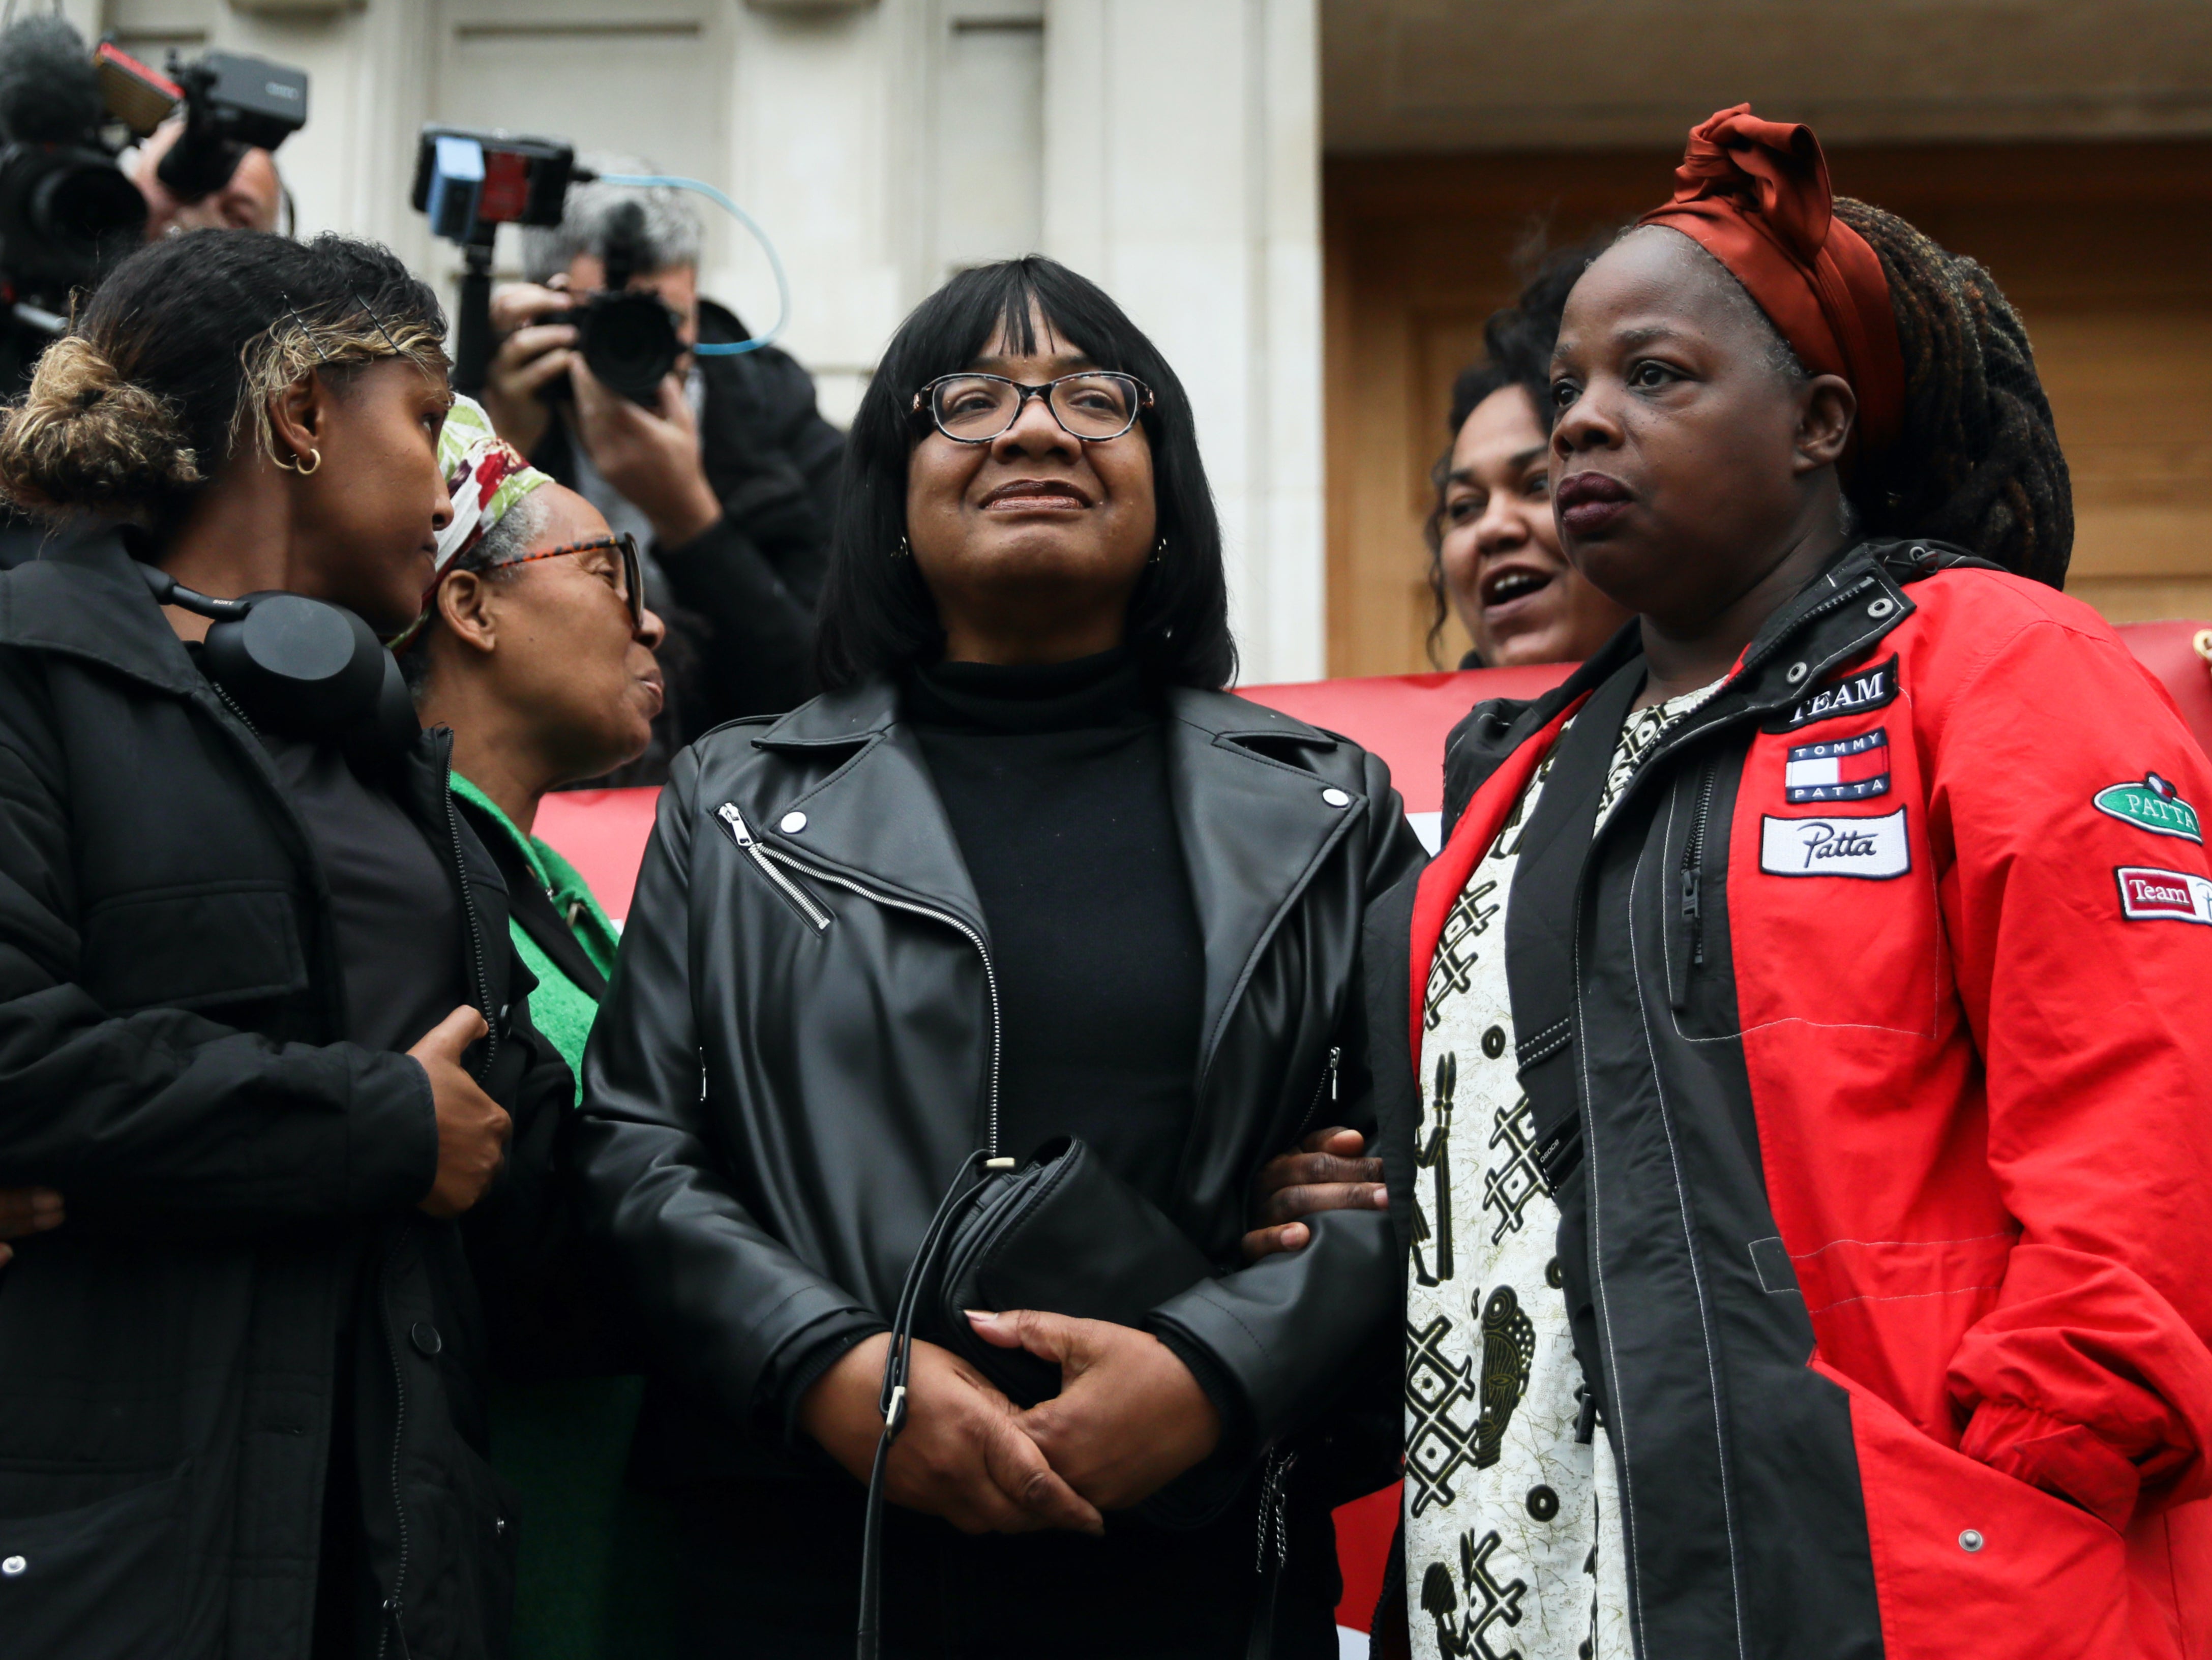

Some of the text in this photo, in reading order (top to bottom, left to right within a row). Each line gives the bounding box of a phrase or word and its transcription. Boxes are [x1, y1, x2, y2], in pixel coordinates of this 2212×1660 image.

[1795, 732, 1878, 757] TOMMY
[1795, 779, 1882, 798] PATTA
[2125, 794, 2197, 832] PATTA
[1797, 822, 1879, 868] Patta
[2129, 879, 2190, 904] Team
